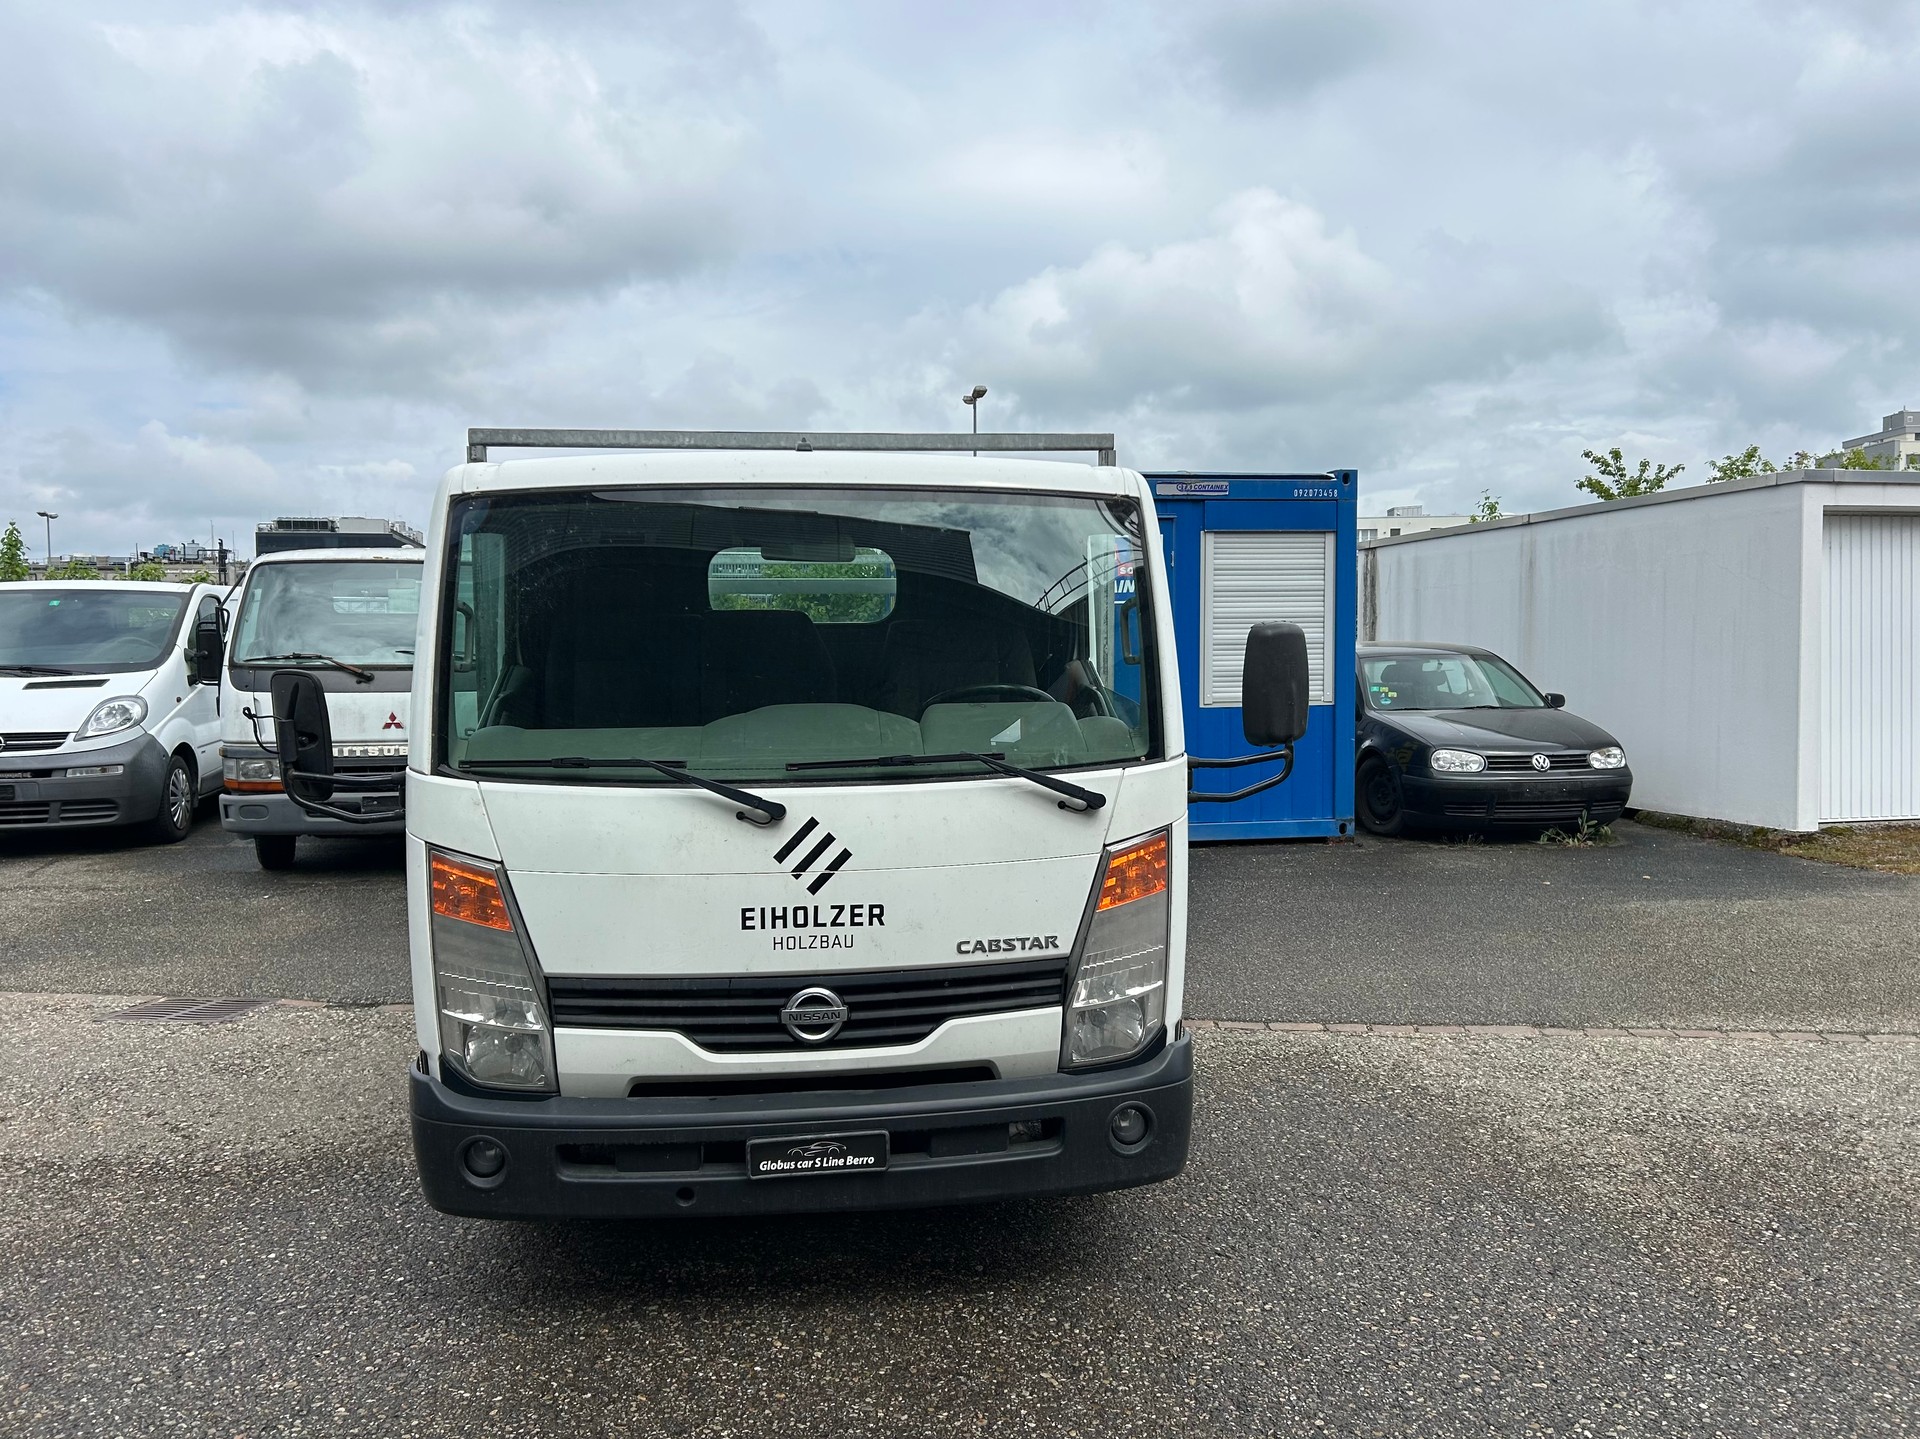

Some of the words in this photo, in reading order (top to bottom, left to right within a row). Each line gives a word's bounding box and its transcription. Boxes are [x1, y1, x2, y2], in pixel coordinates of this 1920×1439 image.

[1293, 488, 1338, 498] 092073458
[741, 904, 885, 930] EIHOLZER
[773, 934, 854, 950] HOLZBAU
[956, 935, 1059, 954] CABSTAR
[788, 1011, 840, 1021] NISSAN
[759, 1159, 796, 1171] Globus
[797, 1159, 814, 1169] car
[815, 1158, 821, 1167] S
[822, 1156, 845, 1167] Line
[846, 1155, 875, 1166] Berro
